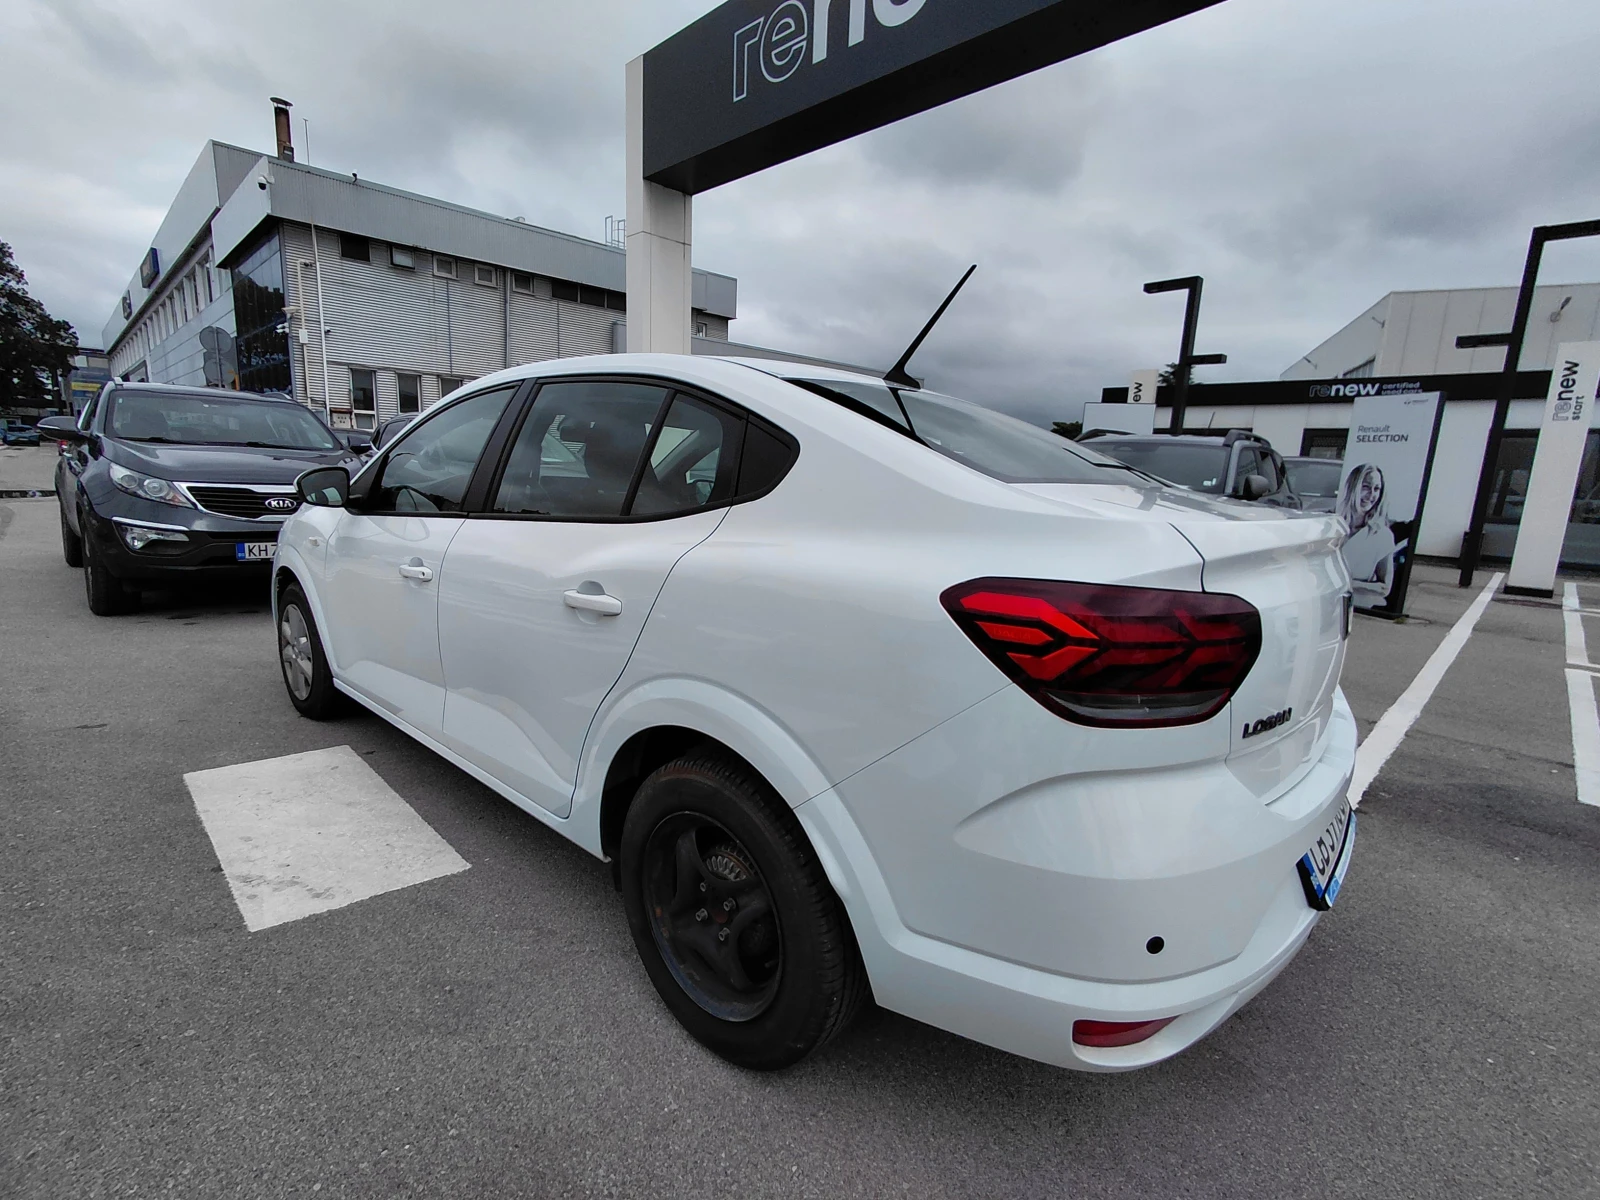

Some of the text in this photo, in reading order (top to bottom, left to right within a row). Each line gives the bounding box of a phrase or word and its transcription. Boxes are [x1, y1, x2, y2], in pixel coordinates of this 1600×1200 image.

[1309, 383, 1379, 397] renew
[1382, 381, 1420, 389] certified
[1552, 360, 1579, 421] renew
[1572, 395, 1585, 421] start
[1358, 424, 1390, 433] Renault
[1356, 434, 1409, 443] SELECTION
[270, 500, 292, 508] KIA
[1242, 707, 1293, 739] LOGAN
